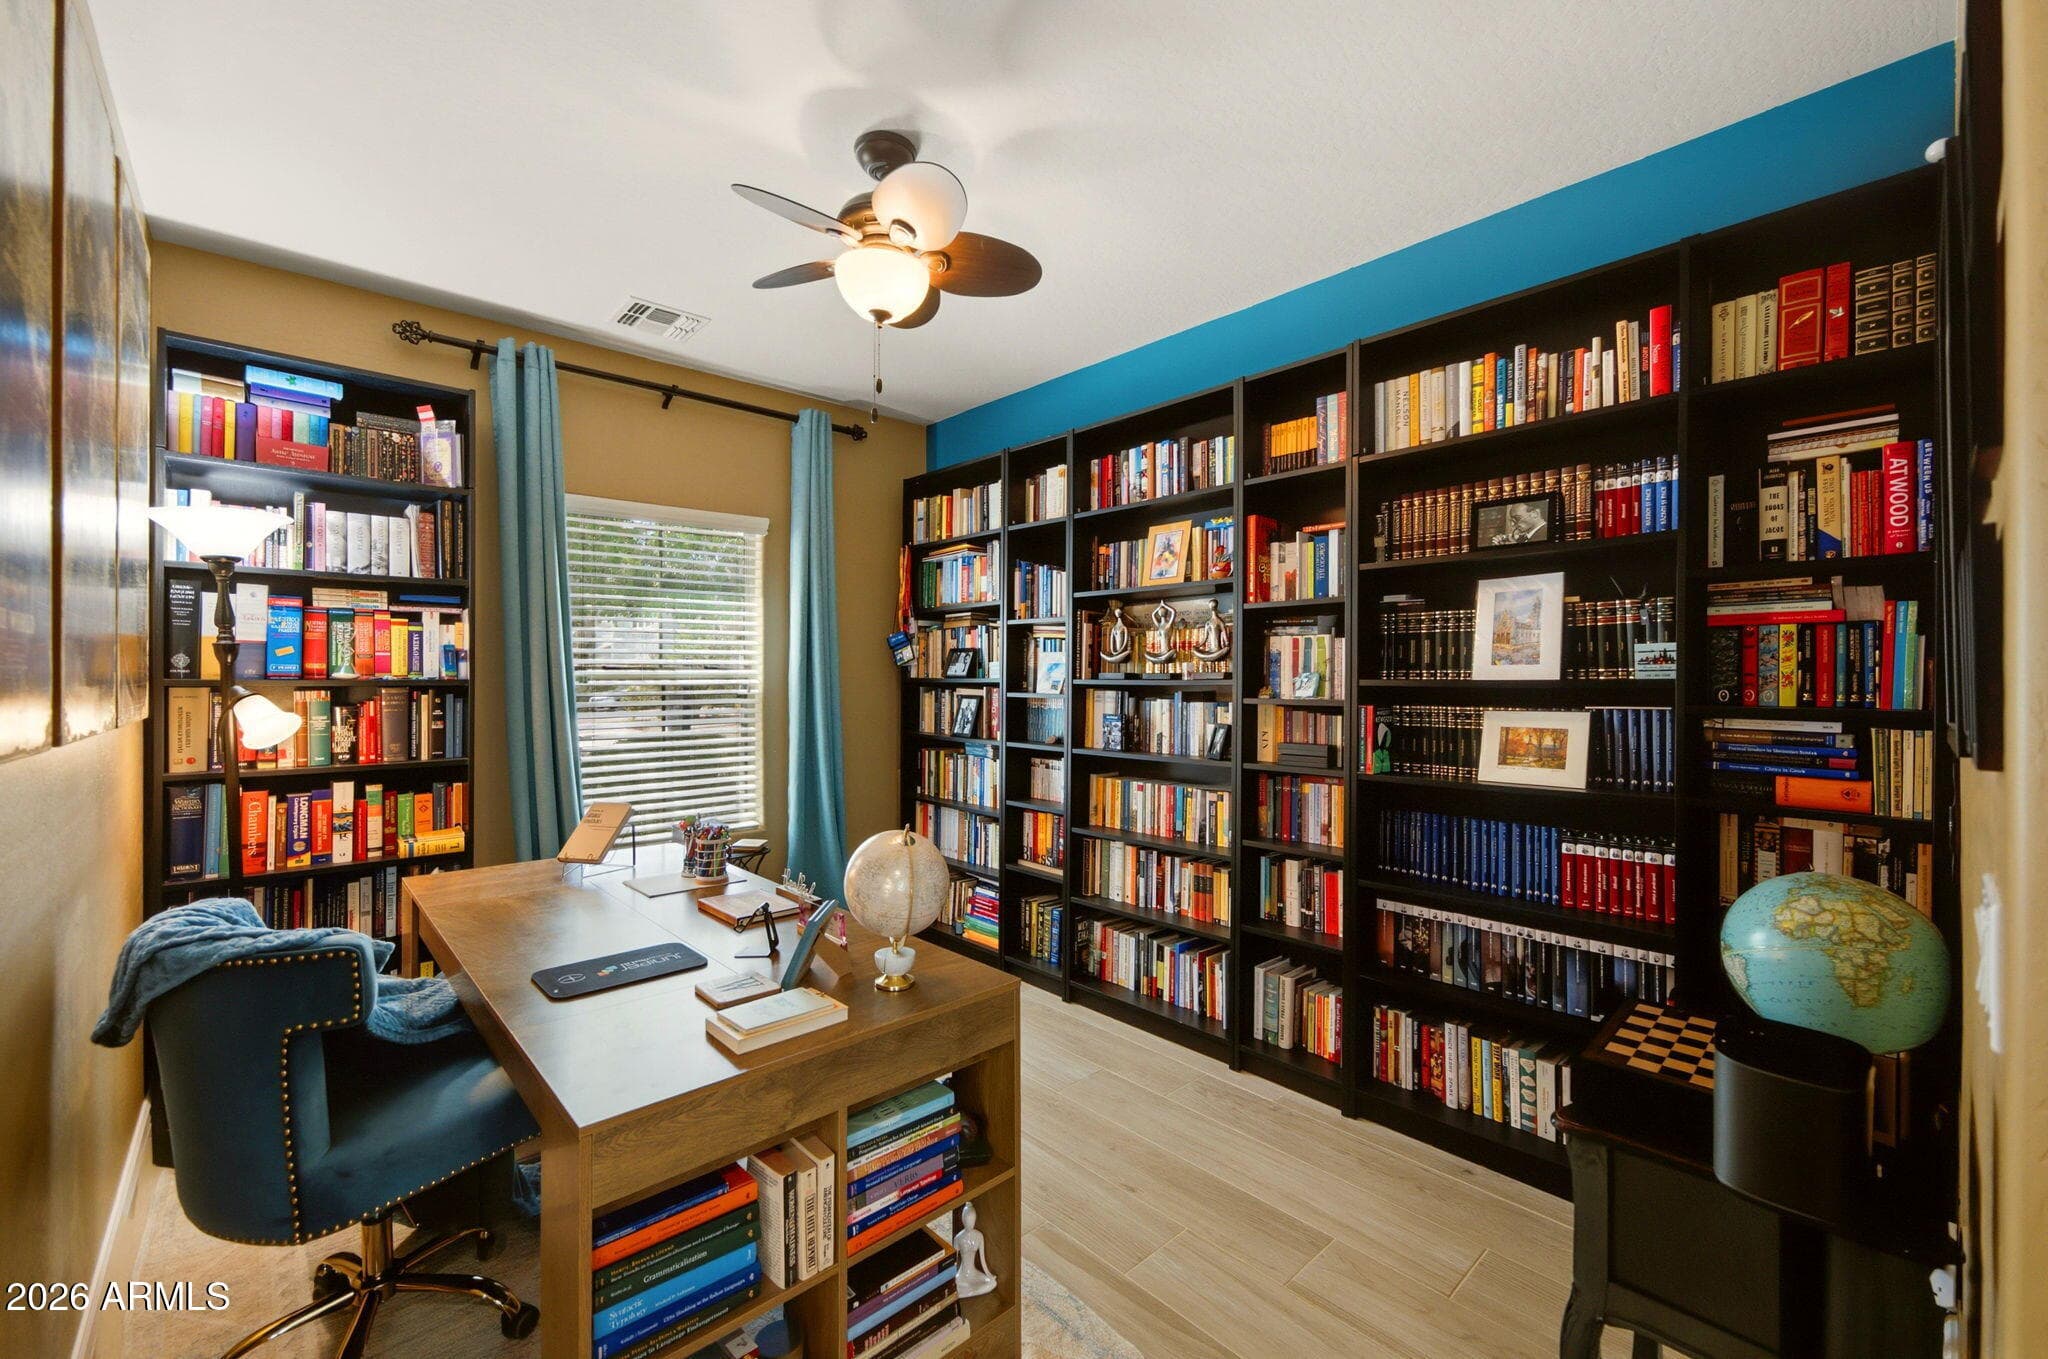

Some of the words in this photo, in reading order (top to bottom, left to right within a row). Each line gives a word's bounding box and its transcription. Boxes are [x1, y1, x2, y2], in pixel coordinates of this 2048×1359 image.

[1889, 458, 1909, 527] ATWOOD
[247, 801, 262, 857] Chambers
[299, 797, 309, 839] LONGMAN
[806, 1196, 815, 1214] THE
[643, 1250, 708, 1284] Grammaticalization
[609, 1298, 644, 1321] Syntactic
